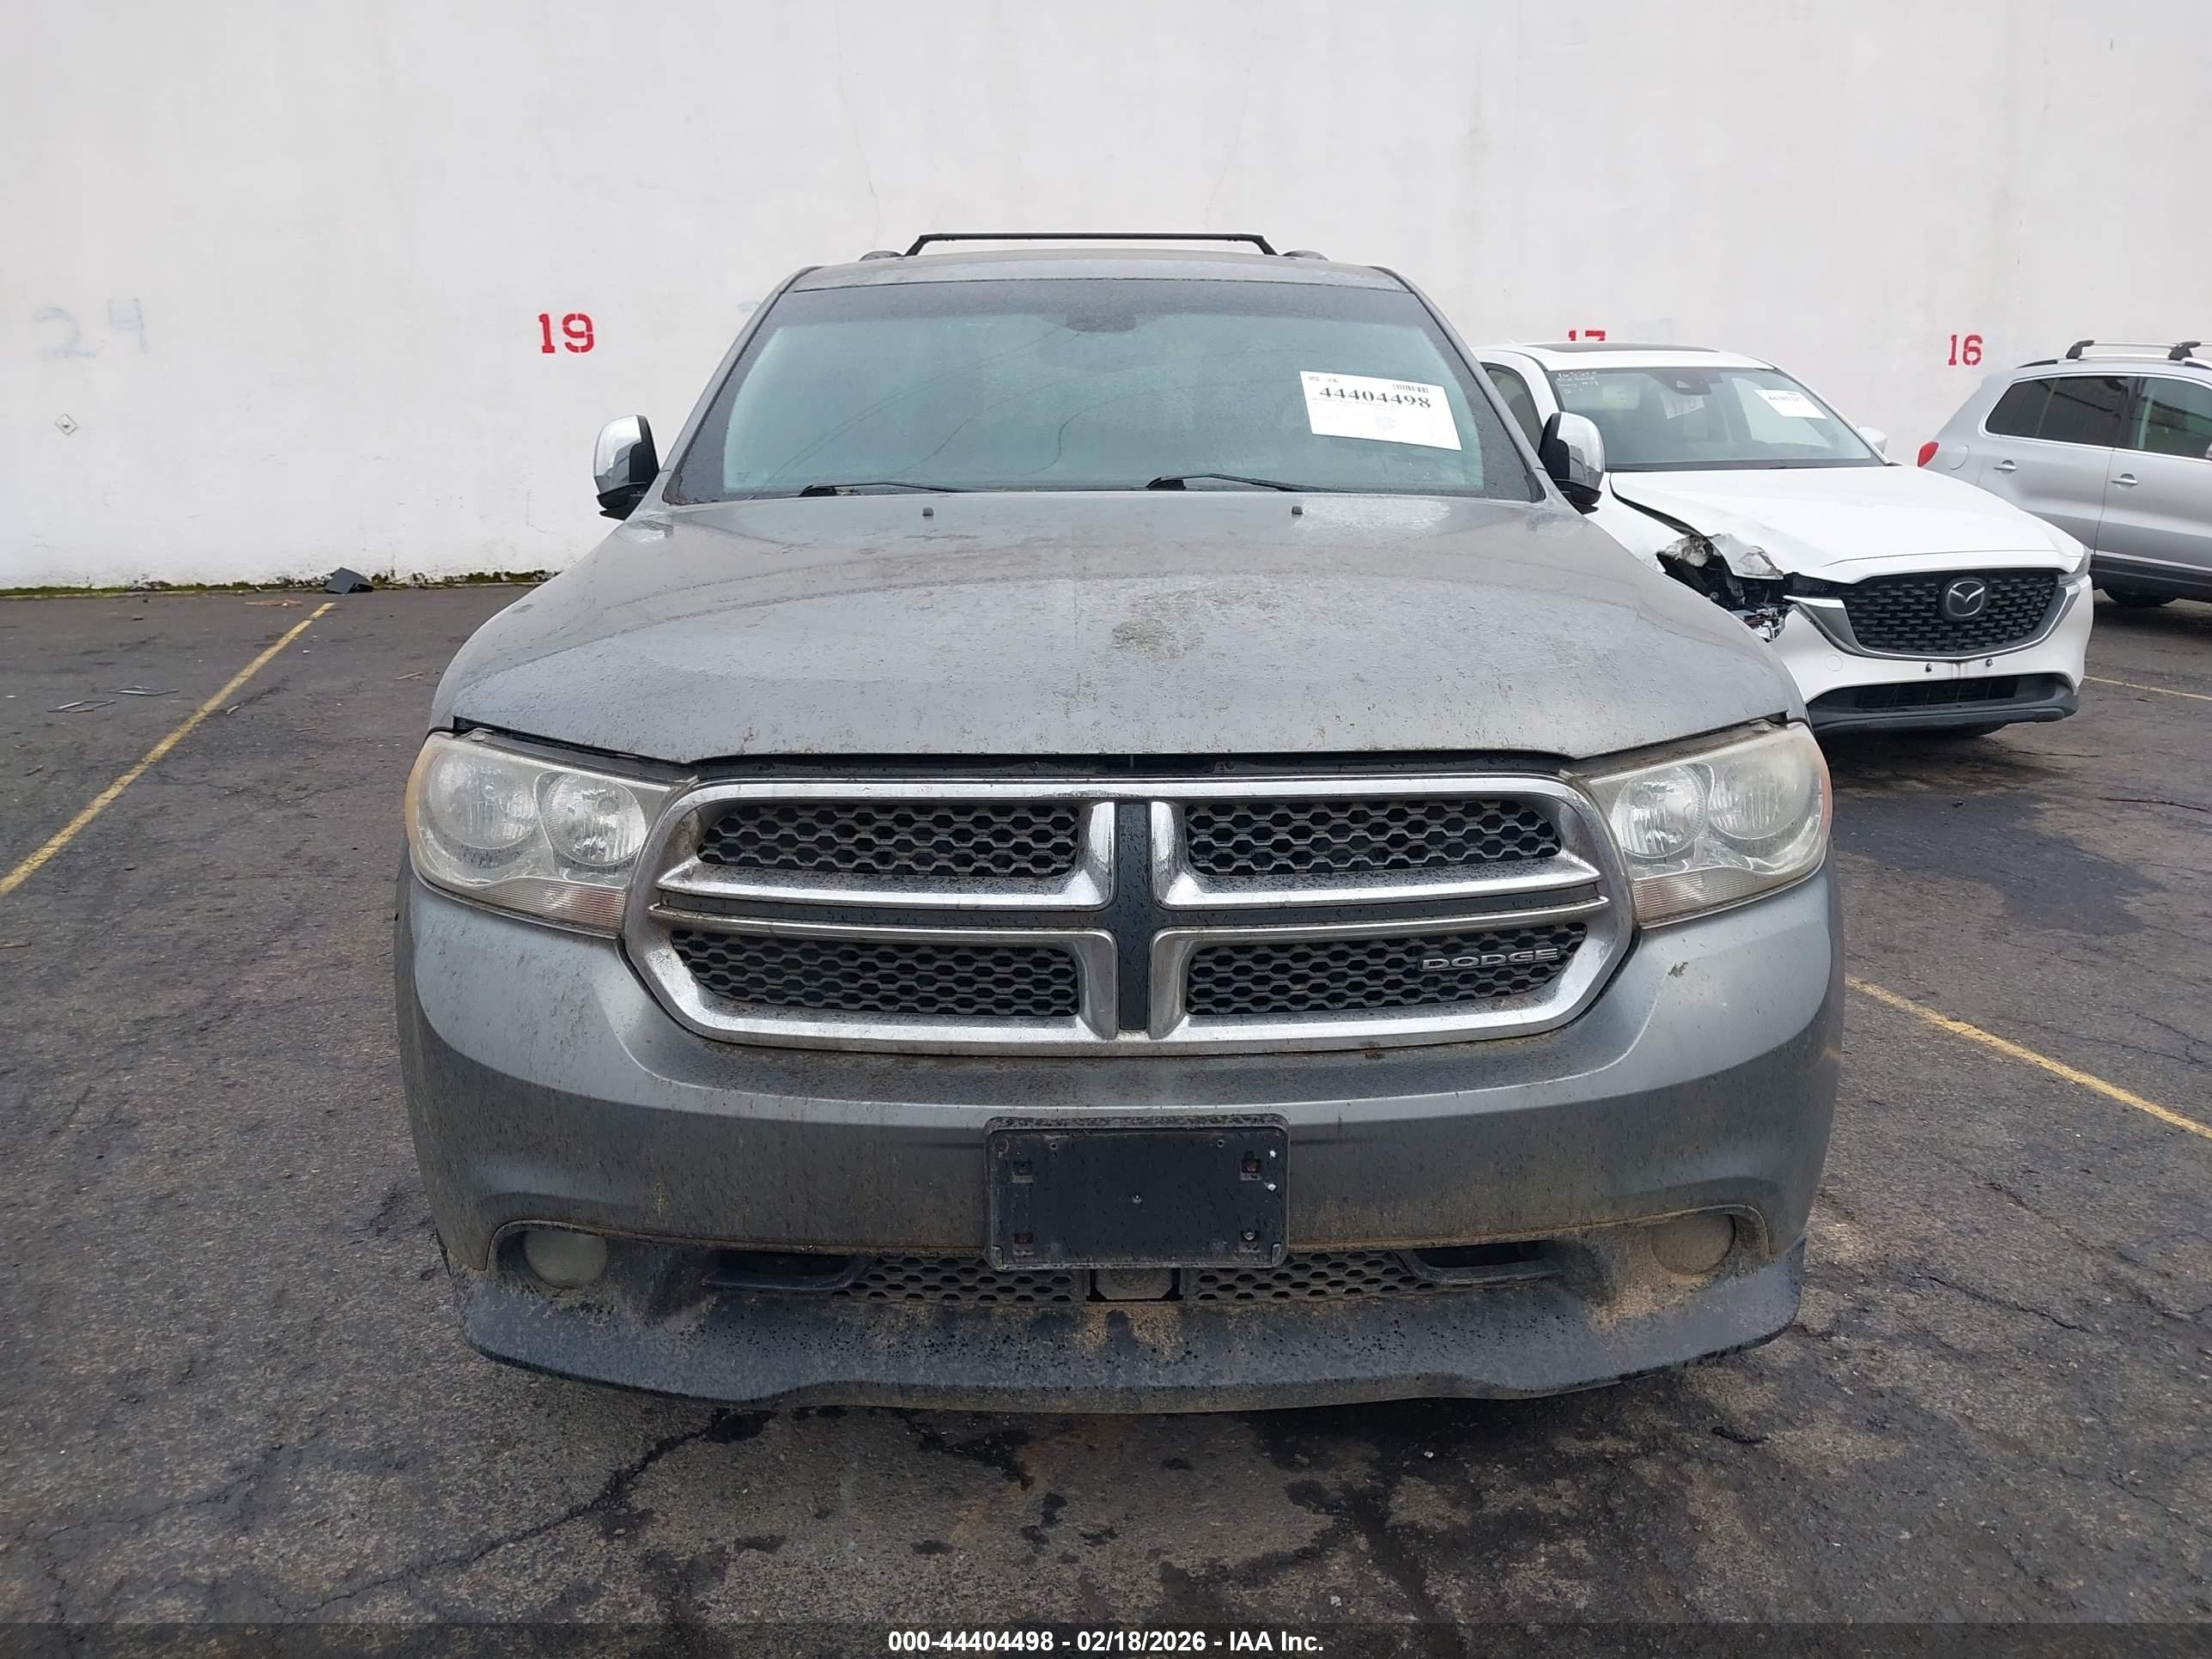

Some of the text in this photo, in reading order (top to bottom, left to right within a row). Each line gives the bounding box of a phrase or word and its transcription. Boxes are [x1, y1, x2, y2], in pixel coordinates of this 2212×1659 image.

[538, 313, 594, 354] 19
[1948, 334, 1984, 366] 16
[1319, 386, 1431, 409] 44404498
[1422, 948, 1559, 969] DODGE
